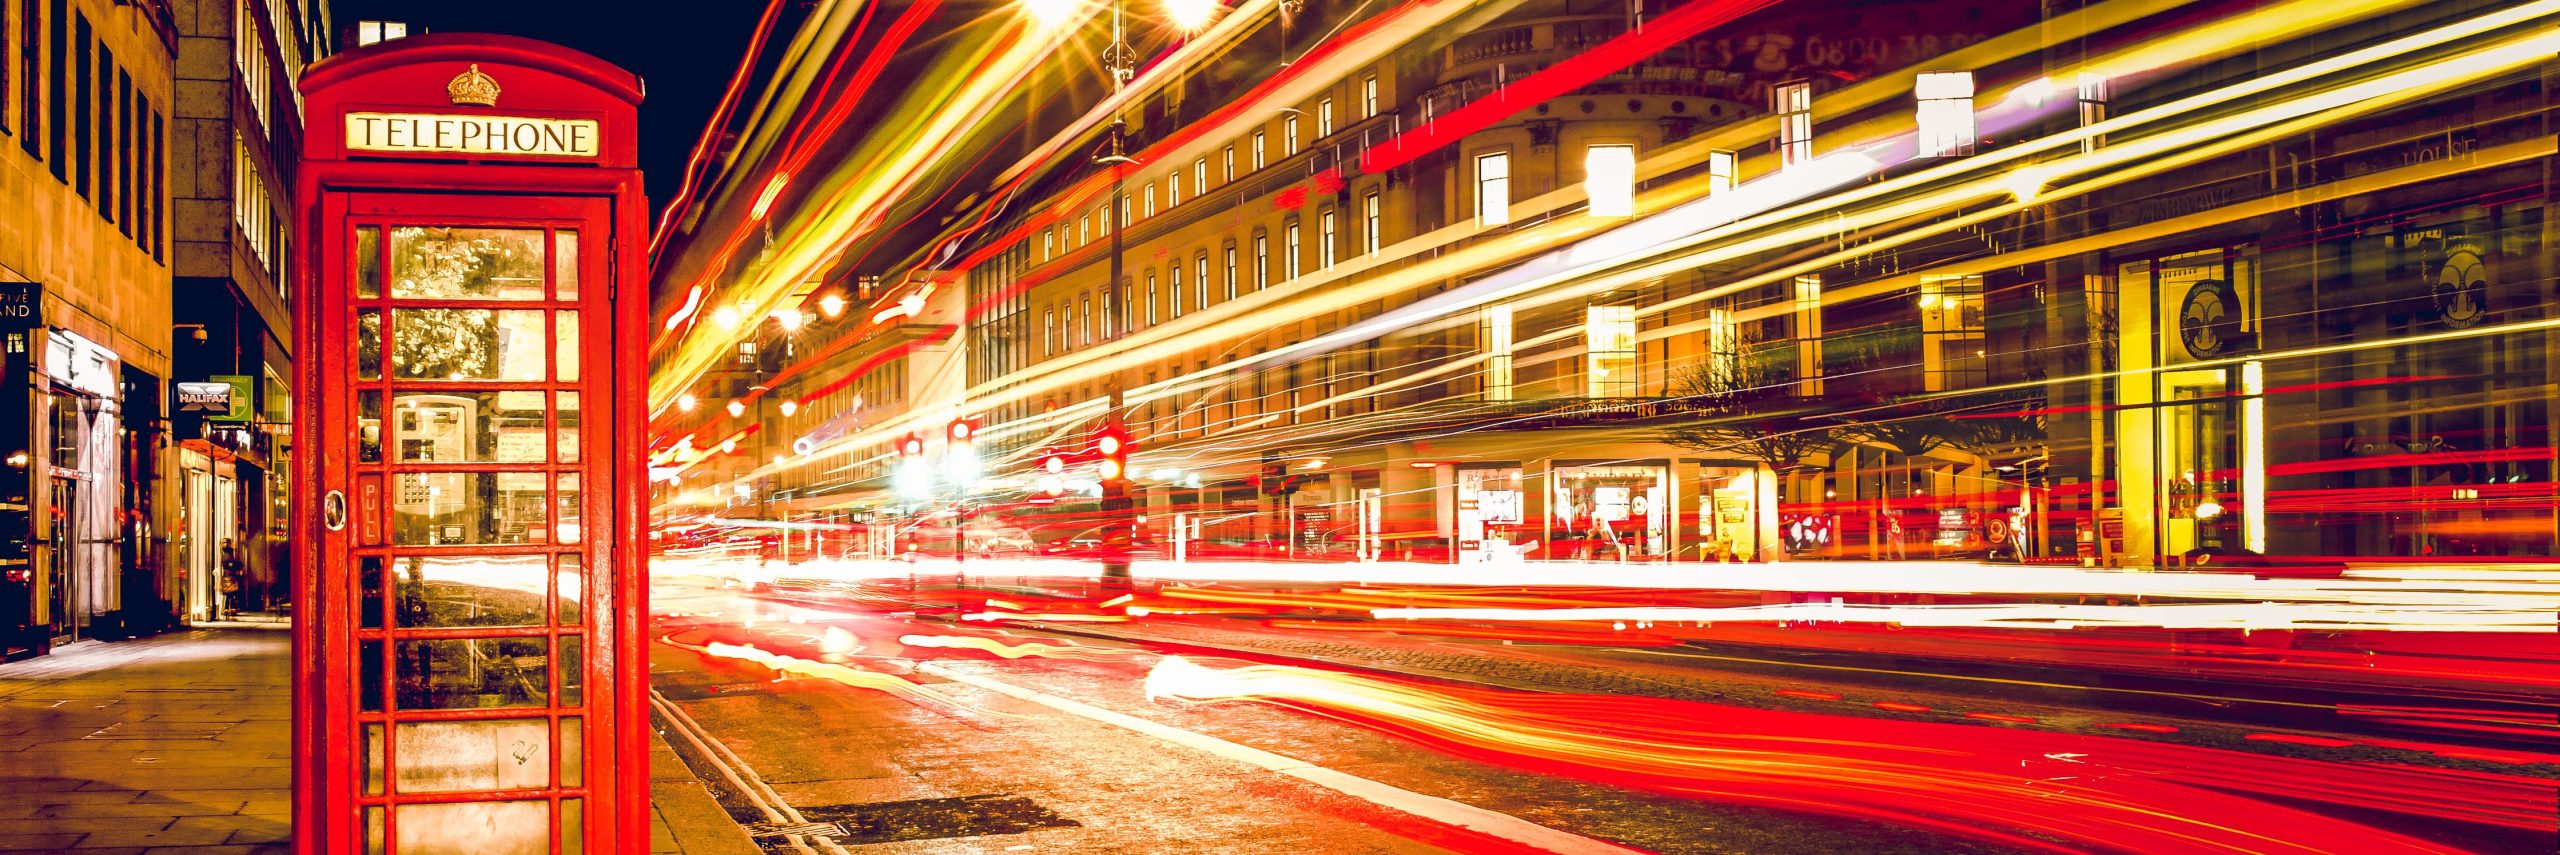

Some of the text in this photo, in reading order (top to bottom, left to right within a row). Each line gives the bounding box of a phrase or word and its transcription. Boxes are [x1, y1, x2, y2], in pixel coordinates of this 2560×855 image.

[356, 118, 589, 153] TELEPHONE
[0, 304, 30, 317] ND
[179, 393, 229, 403] HALIFAX
[366, 484, 375, 538] PULL
